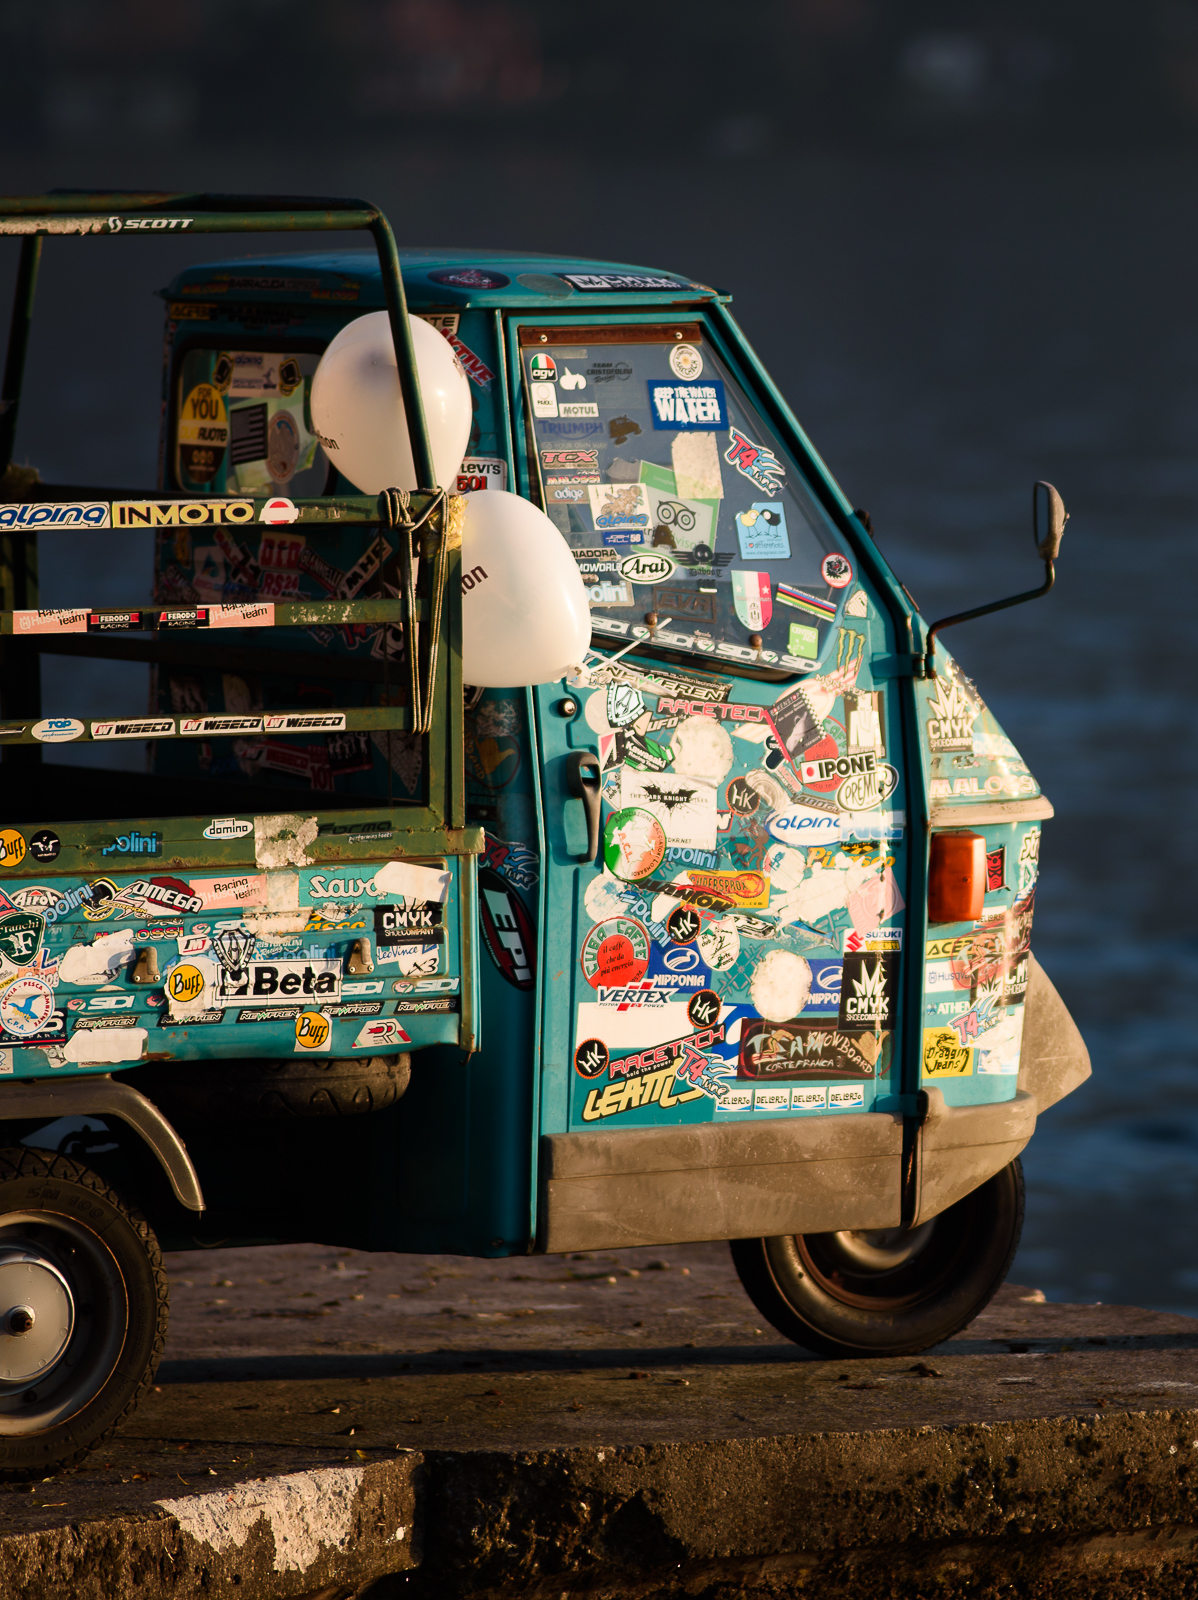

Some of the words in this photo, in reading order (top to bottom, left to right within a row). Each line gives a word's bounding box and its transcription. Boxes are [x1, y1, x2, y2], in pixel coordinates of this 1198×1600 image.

[123, 218, 194, 229] SCOTT
[532, 369, 555, 379] agv
[190, 399, 219, 420] YOU
[654, 397, 721, 424] WATER
[536, 420, 605, 435] TRIUMPH
[542, 451, 598, 463] TCX
[456, 475, 488, 491] 501
[554, 487, 584, 502] adige
[0, 504, 107, 528] alpina
[118, 502, 254, 525] INMOTO
[596, 514, 649, 528] alpina
[623, 559, 667, 576] Arai
[58, 613, 86, 626] Team
[100, 614, 130, 623] FERODO
[167, 611, 196, 620] FERODO
[241, 606, 268, 620] Team
[48, 720, 72, 729] TOP
[646, 717, 679, 732] UFO
[927, 718, 974, 739] CMYK
[817, 754, 876, 779] IPONE
[209, 819, 248, 835] domino
[668, 846, 718, 869] polini
[135, 881, 202, 914] OMEGA
[42, 884, 95, 928] polini
[382, 910, 434, 929] CMYK
[865, 930, 902, 939] SUZUKI
[585, 926, 607, 977] CUBA
[252, 966, 337, 995] Beta
[653, 974, 706, 987] NIPPONIA
[2, 987, 18, 1010] CACCIA
[23, 981, 43, 991] PESCA
[599, 989, 673, 1004] VERTEX
[691, 995, 718, 1023] HK
[846, 996, 890, 1014] CMYK
